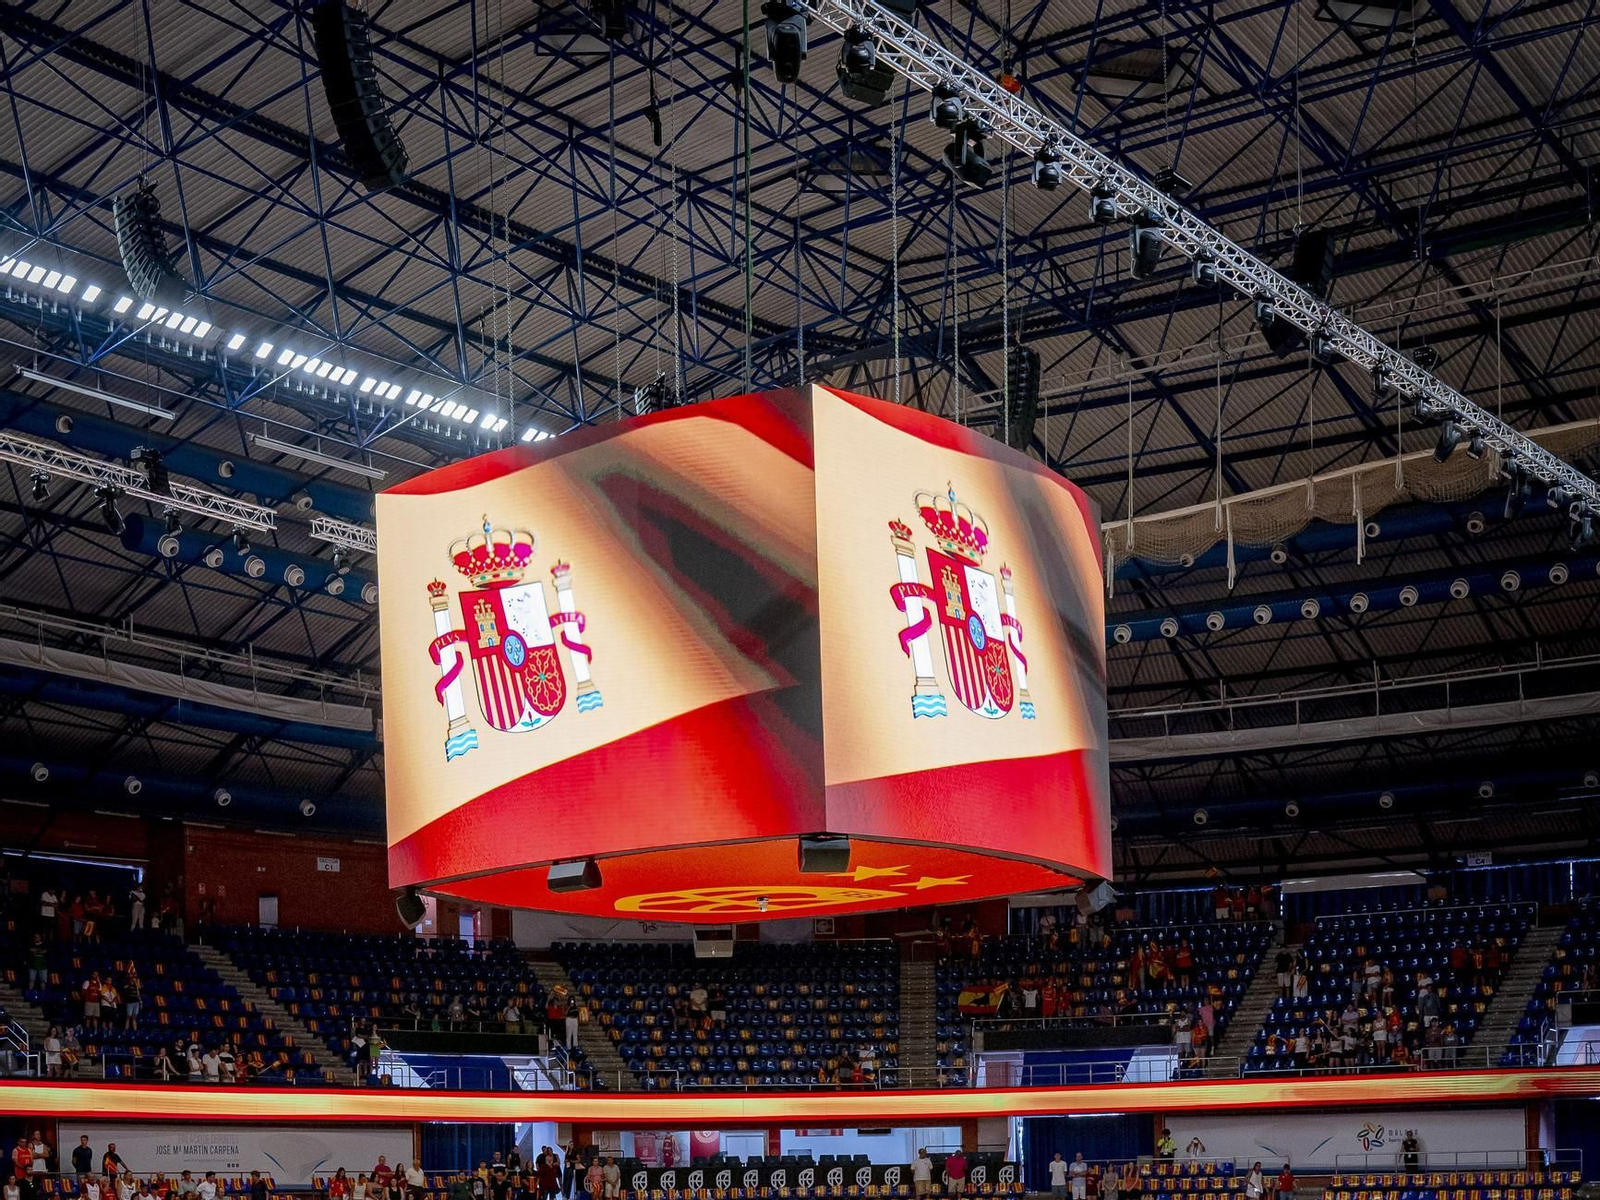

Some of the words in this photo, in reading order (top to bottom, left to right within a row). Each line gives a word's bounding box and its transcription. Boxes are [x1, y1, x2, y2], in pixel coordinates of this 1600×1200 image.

[898, 585, 928, 599] PLVS
[434, 632, 460, 649] PLVS
[155, 1144, 171, 1155] JOSÉ
[183, 1144, 208, 1155] MARTÍN
[210, 1145, 239, 1155] CARPENA
